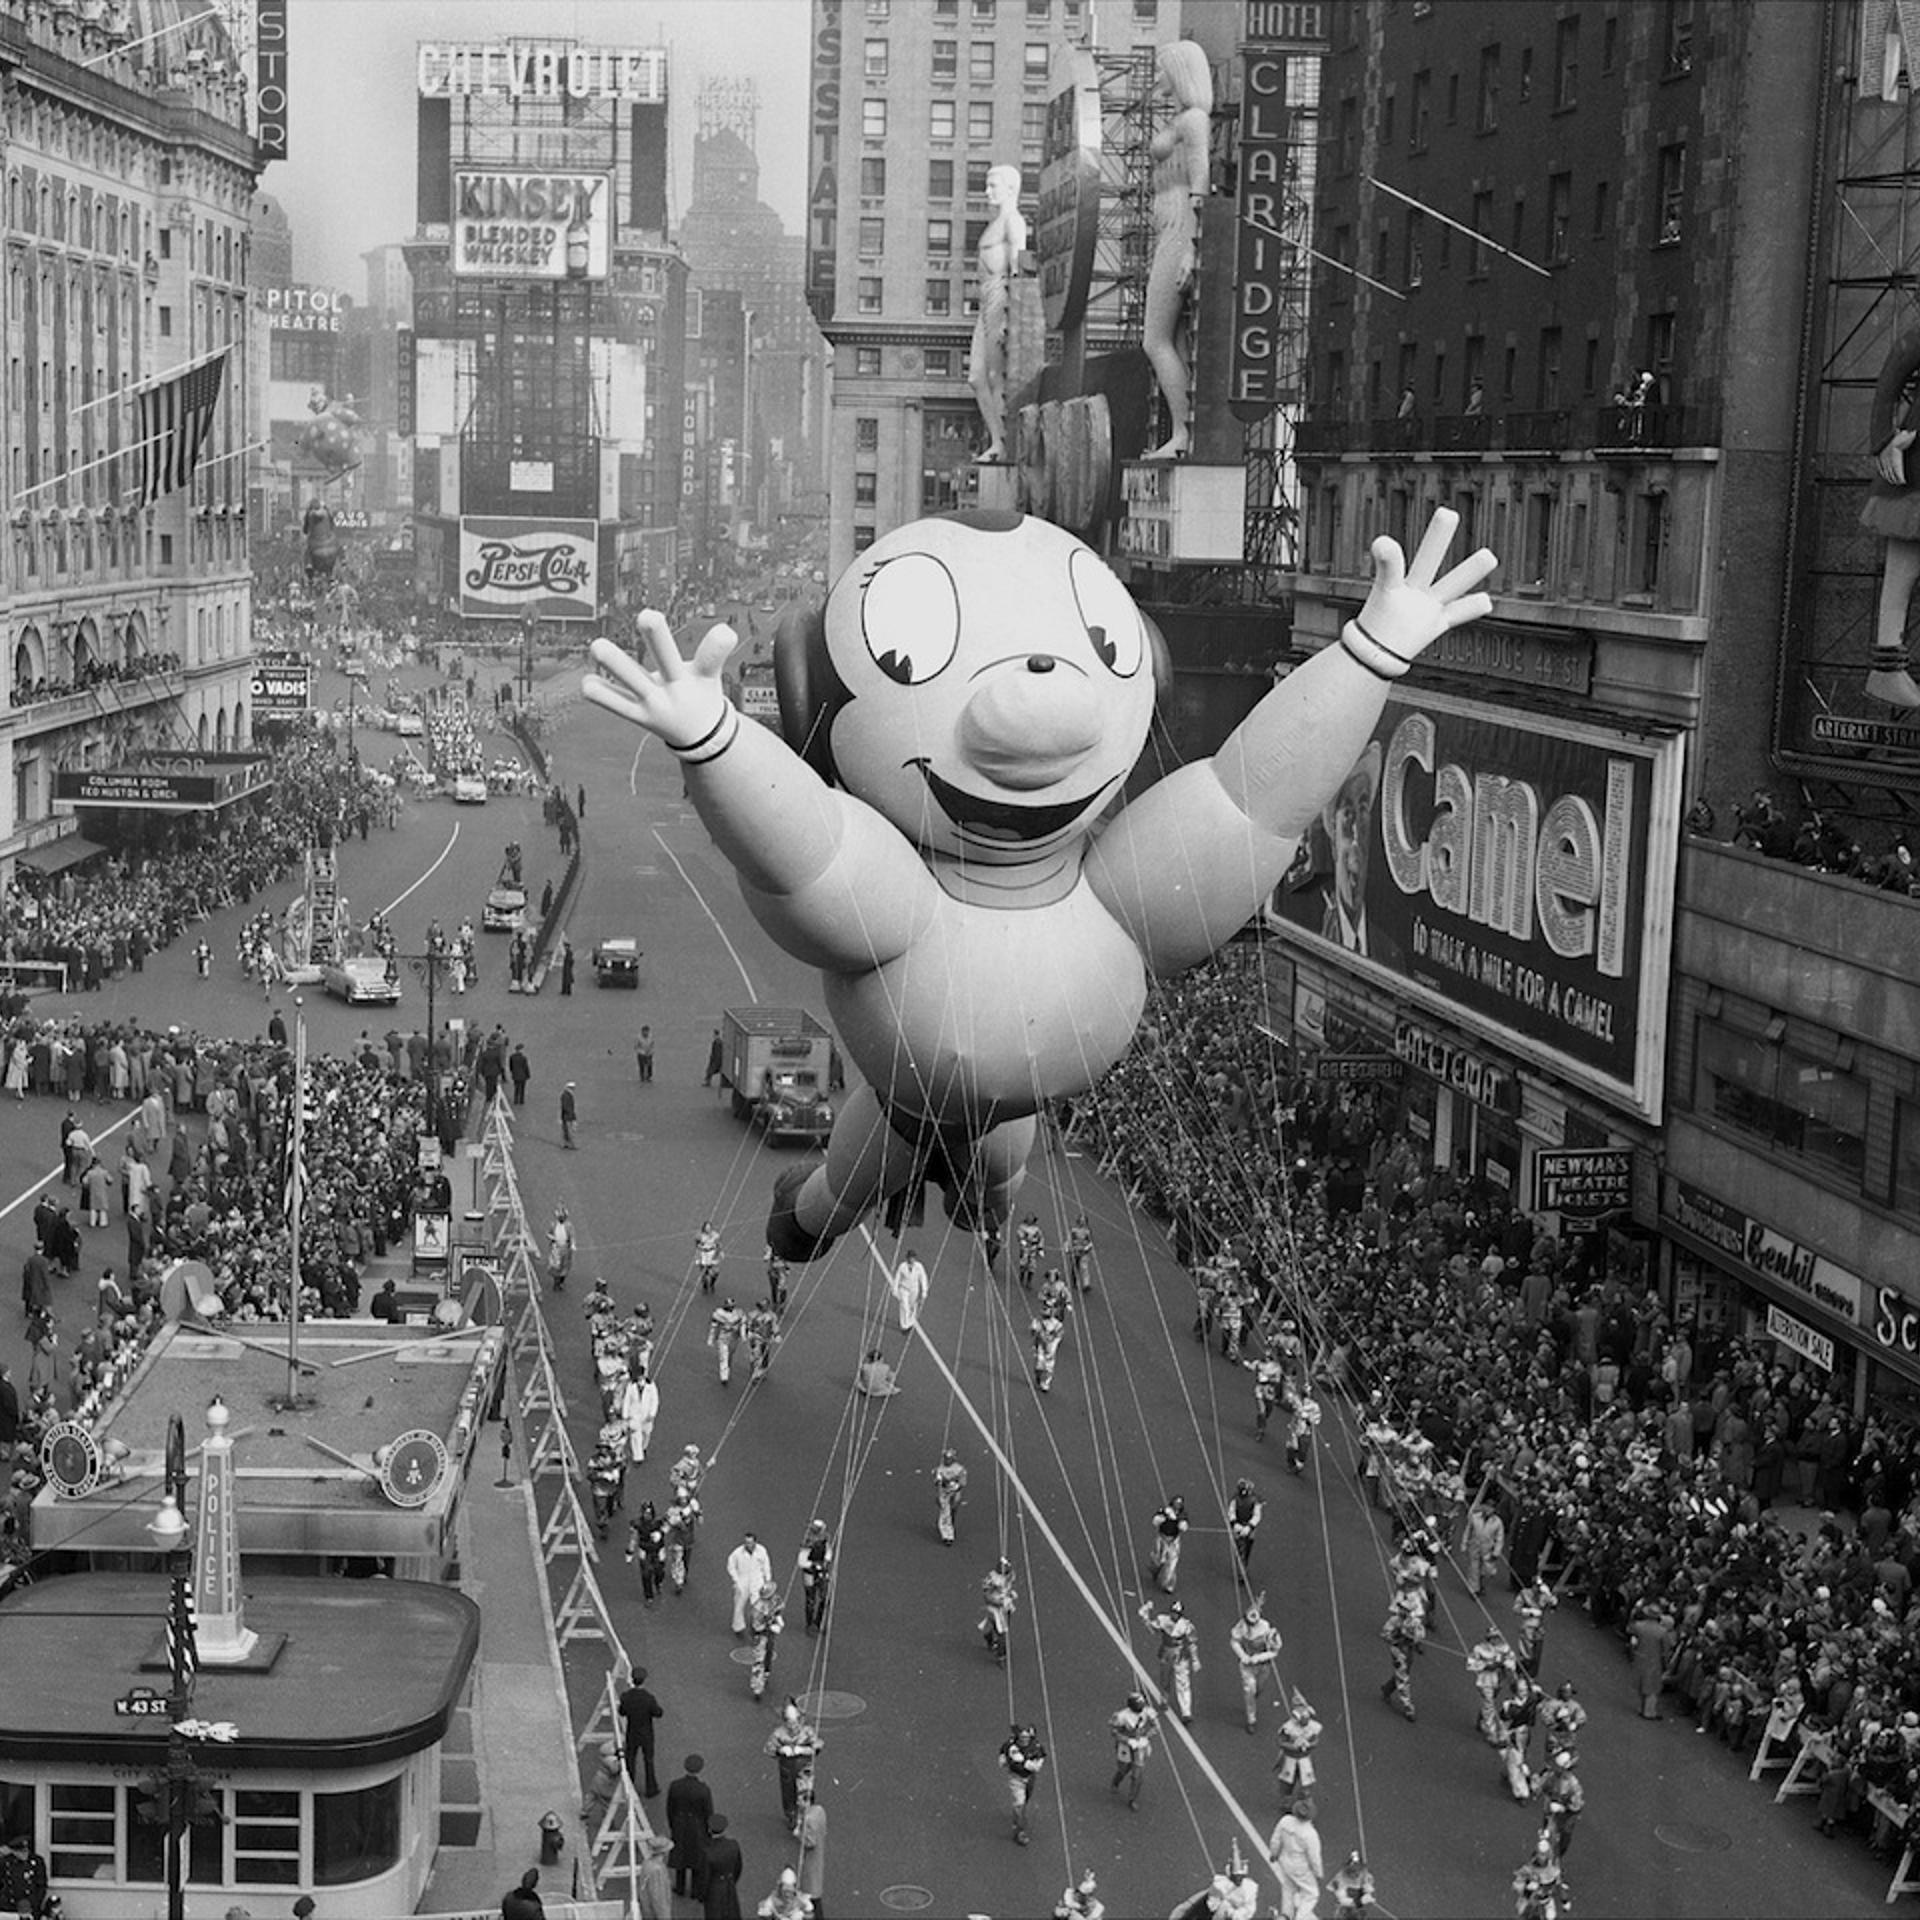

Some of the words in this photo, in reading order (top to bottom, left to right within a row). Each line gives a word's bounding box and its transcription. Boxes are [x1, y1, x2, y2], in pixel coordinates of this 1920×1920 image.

[1249, 3, 1326, 38] HOTEL
[258, 11, 286, 150] STOR
[813, 83, 838, 280] STATE
[459, 176, 603, 220] KINSEY
[465, 225, 557, 244] BLENDED
[1241, 61, 1280, 400] CLARIDGE
[465, 245, 553, 266] WHISKEY
[267, 289, 343, 312] PITOL
[683, 399, 695, 495] HOWARD
[266, 681, 306, 696] VADIS
[1817, 719, 1879, 742] ARTKRAFT
[139, 757, 204, 777] ASTOR
[1381, 711, 1635, 979] Camel
[1430, 928, 1465, 974] WALK
[1466, 946, 1479, 980] A
[1480, 951, 1513, 997] MILE
[1515, 965, 1545, 1012] FOR
[1547, 981, 1561, 1019] A
[1563, 987, 1615, 1044] CAMEL
[1543, 1154, 1630, 1175] NEWMAN'S
[1543, 1175, 1629, 1191] THEATRE
[205, 1473, 219, 1595] POLICE
[131, 1700, 148, 1714] 43
[150, 1699, 167, 1713] ST
